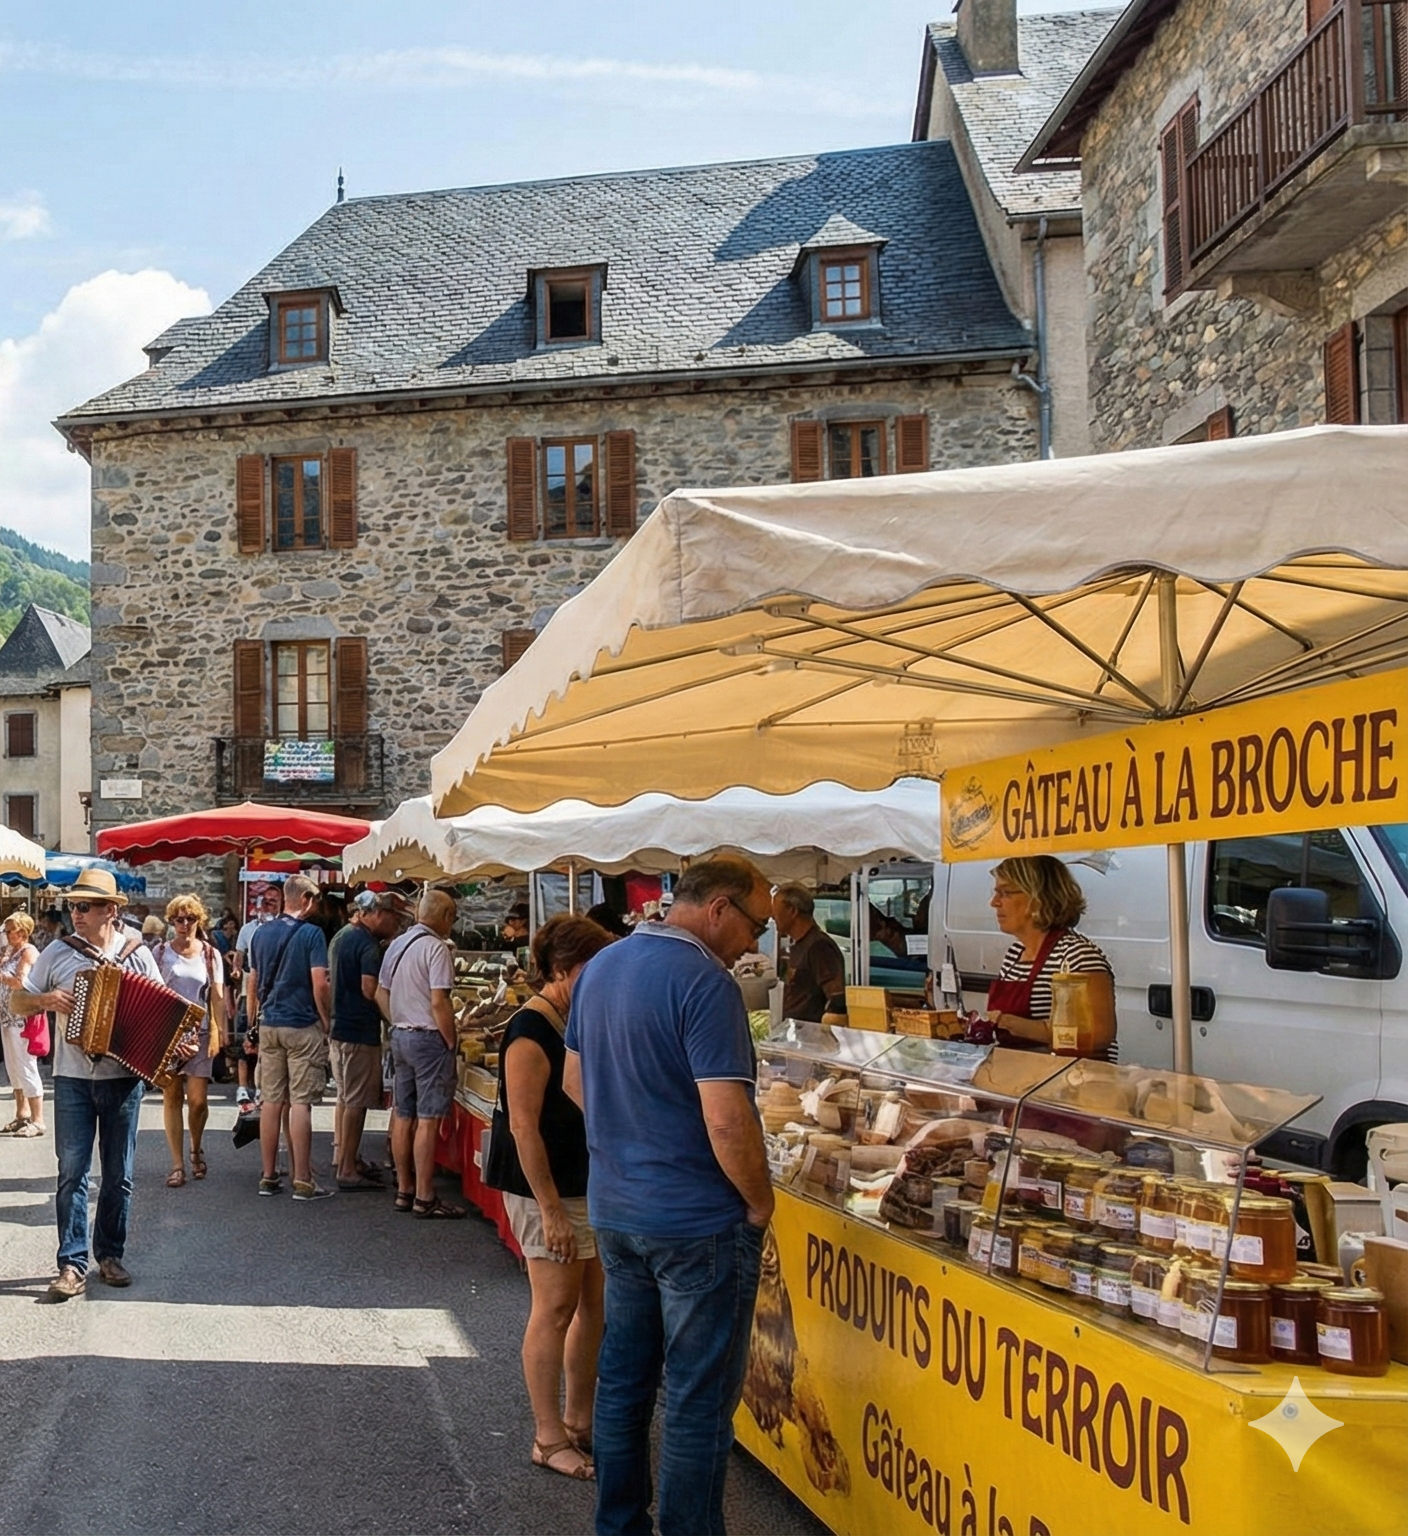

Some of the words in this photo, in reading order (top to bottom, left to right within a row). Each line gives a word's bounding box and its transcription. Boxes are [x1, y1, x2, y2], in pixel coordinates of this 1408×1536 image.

[1002, 759, 1113, 843] GÂTEAU
[1119, 737, 1145, 829] À
[1153, 746, 1199, 825] LA
[1210, 708, 1398, 819] BROCHE
[806, 1232, 932, 1370] PRODUITS
[941, 1297, 986, 1402] DU
[996, 1326, 1191, 1525] TERROIR
[862, 1401, 951, 1536] Gâteau
